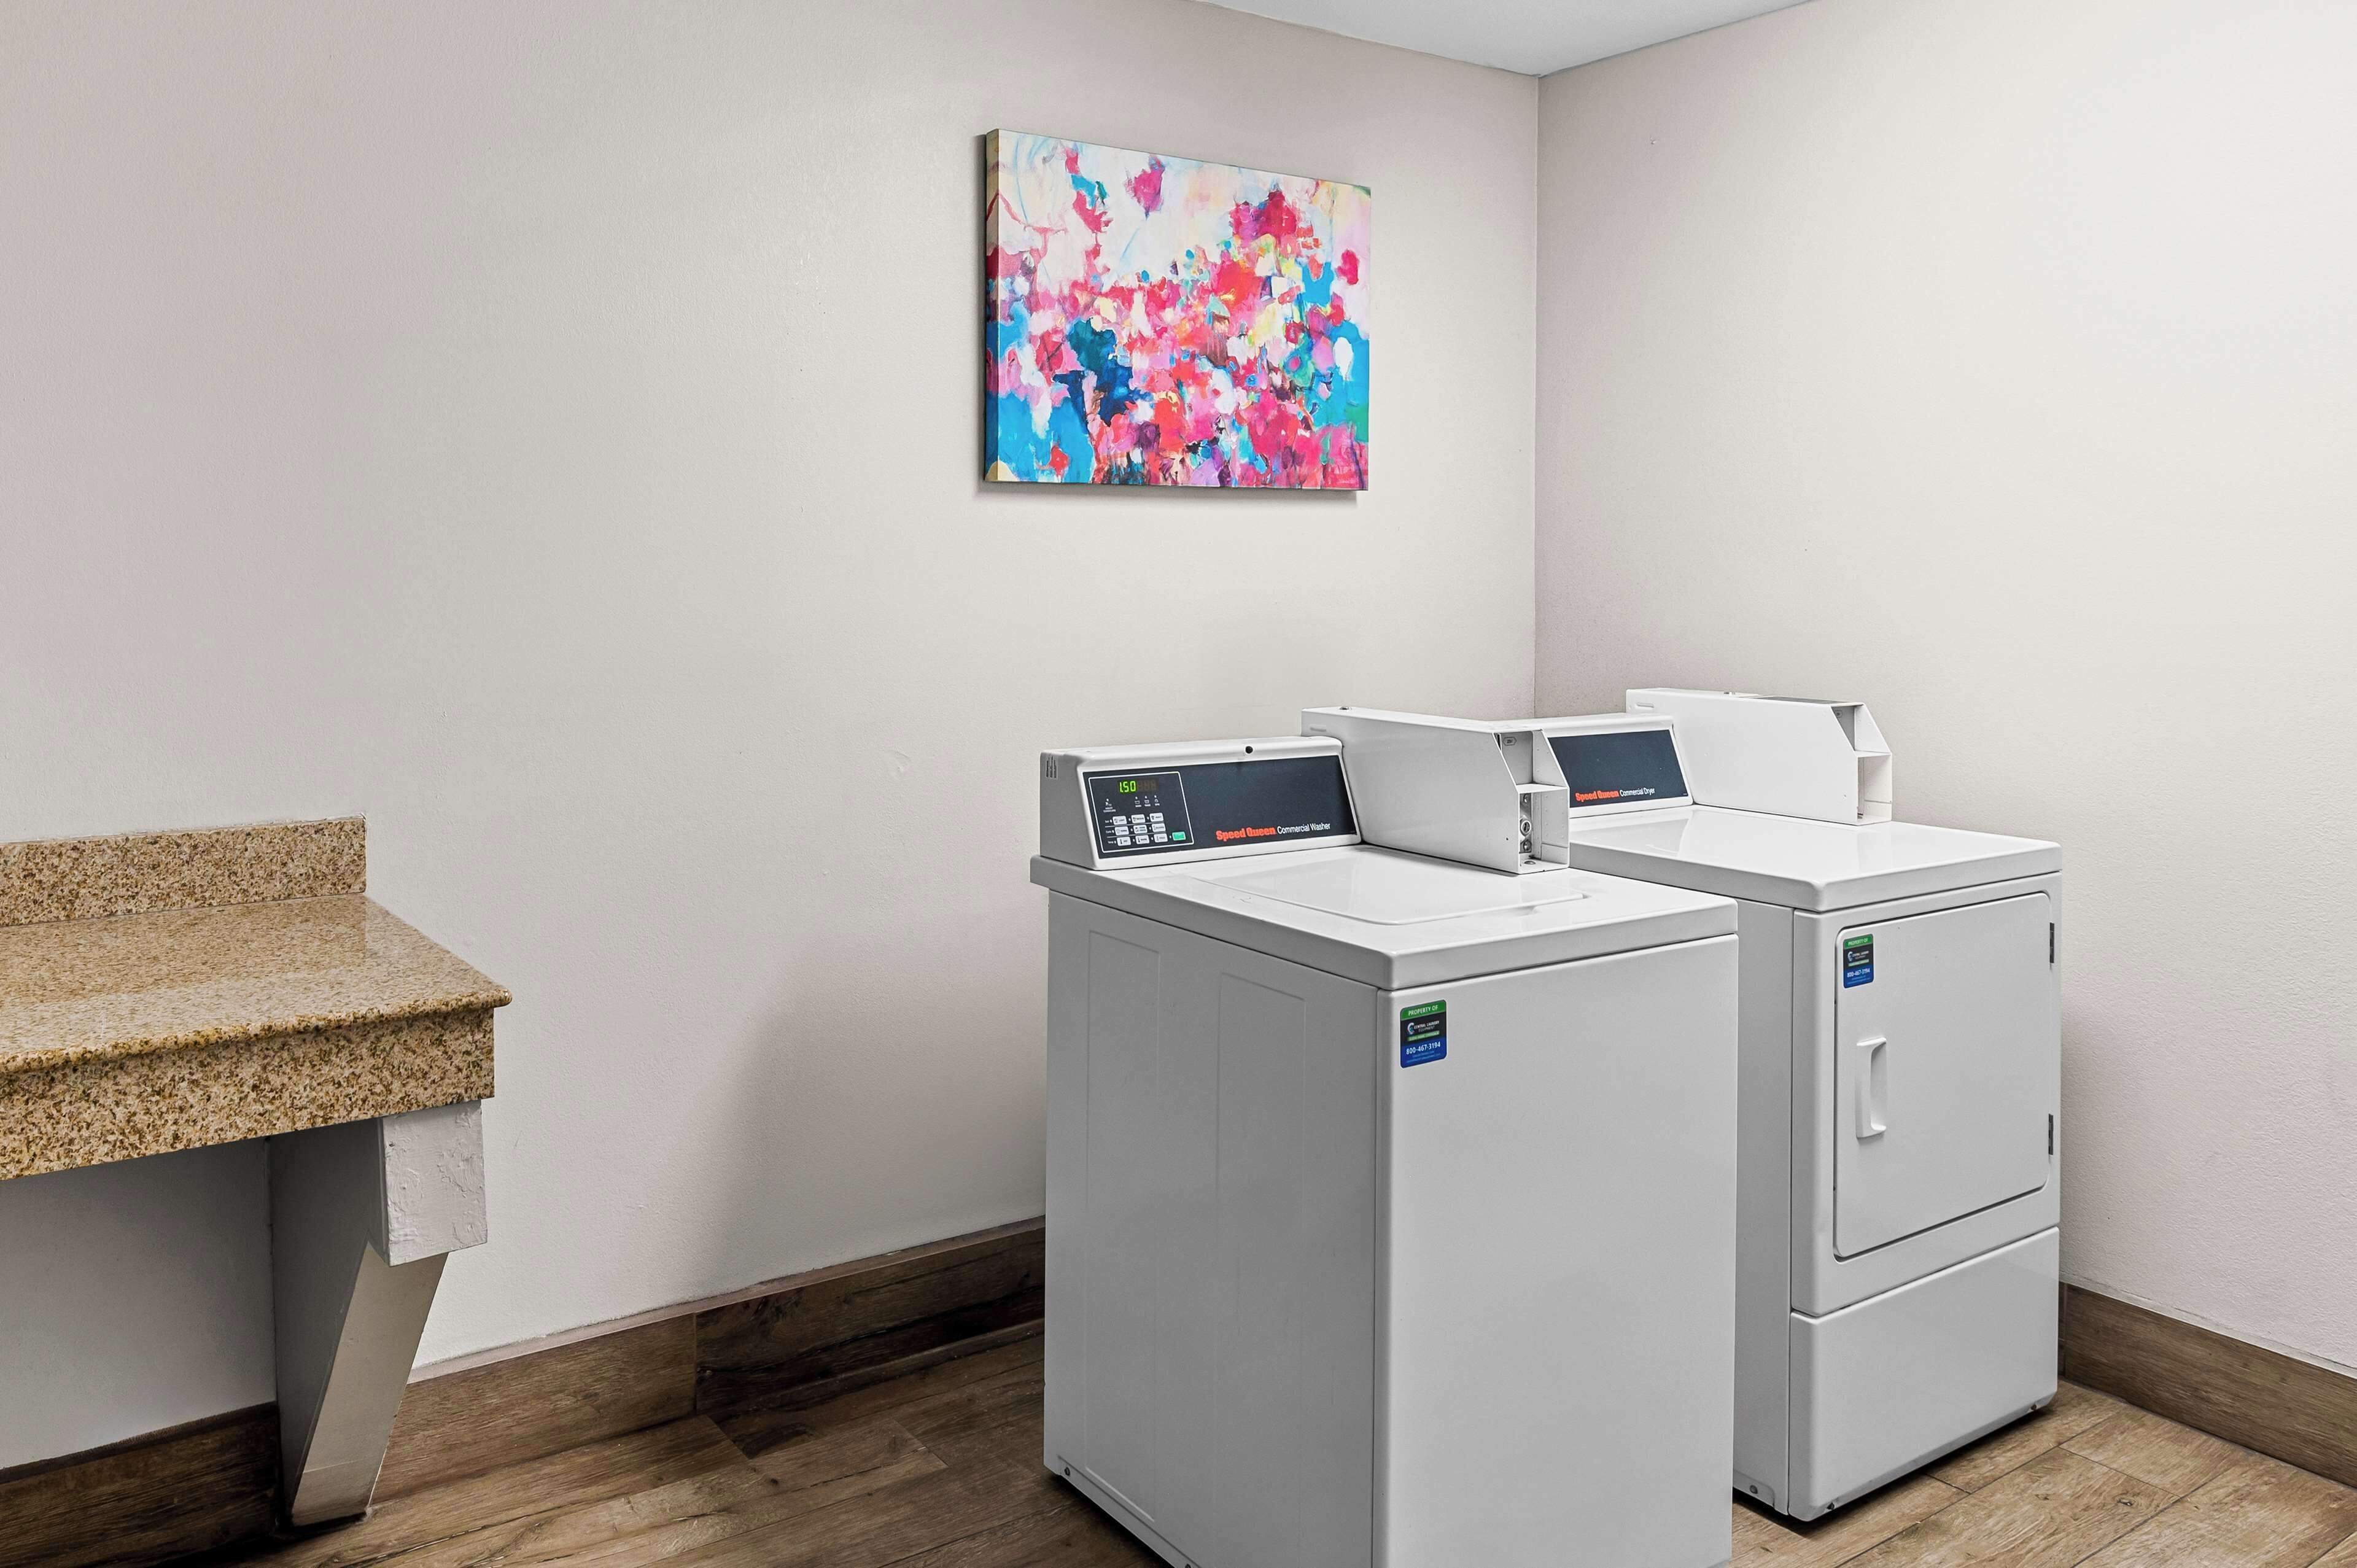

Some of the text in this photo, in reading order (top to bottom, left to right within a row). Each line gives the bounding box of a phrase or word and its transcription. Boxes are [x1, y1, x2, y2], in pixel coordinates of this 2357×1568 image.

[1575, 791, 1597, 802] Speed
[1597, 790, 1620, 799] Queen
[1619, 788, 1644, 797] Commercial
[1216, 822, 1330, 841] Speed Queen Commercial Washer
[1408, 1007, 1431, 1016] PROPERTY
[1406, 1041, 1440, 1055] 800-467-3194
